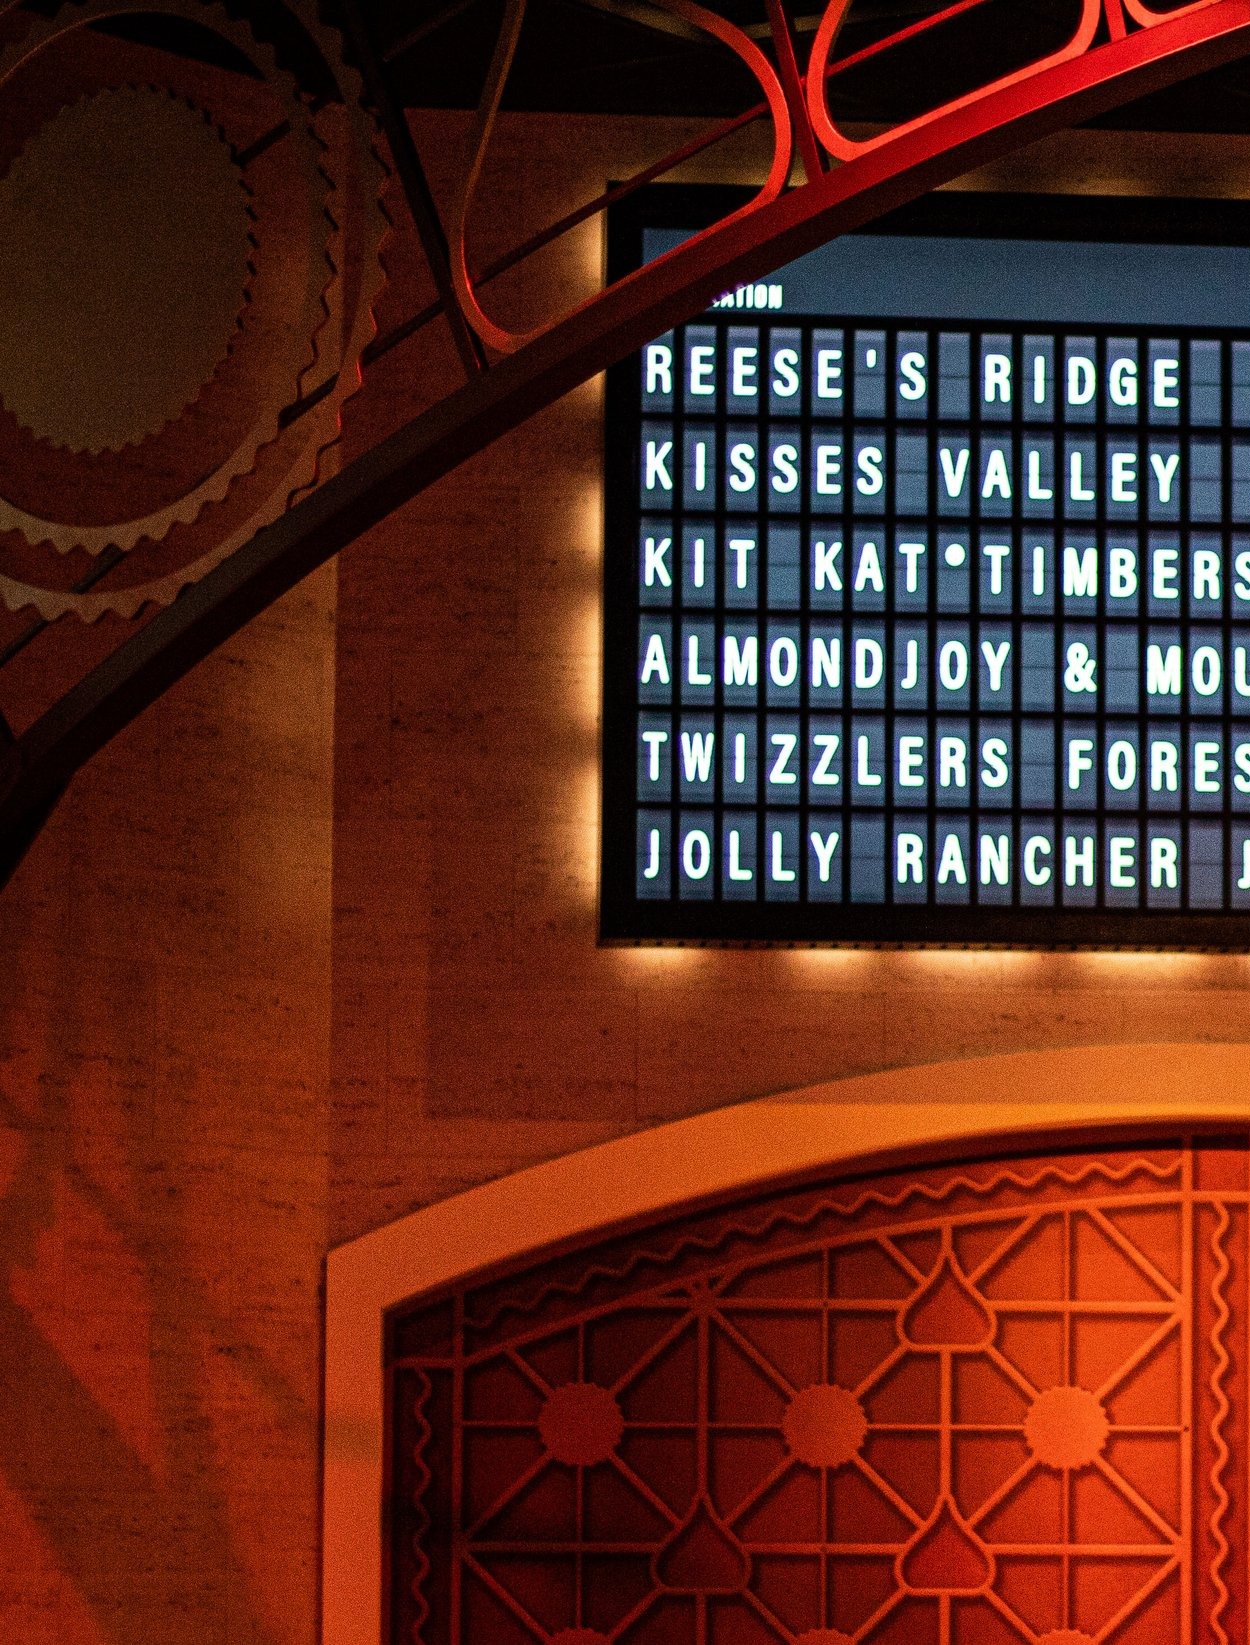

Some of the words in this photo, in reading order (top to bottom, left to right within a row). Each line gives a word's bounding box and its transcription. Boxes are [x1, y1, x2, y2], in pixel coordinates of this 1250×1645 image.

[646, 345, 926, 400] REESE'S
[984, 354, 1179, 408] RIDGE
[646, 441, 883, 496] KISSES
[939, 448, 1180, 503] VALLEY
[644, 537, 756, 589] KIT
[641, 634, 1011, 692] ALMONDJOY
[1063, 642, 1097, 693] &
[642, 731, 1009, 788] TWIZZLERS
[643, 828, 839, 882] JOLLY
[897, 833, 1178, 888] RANCHER
